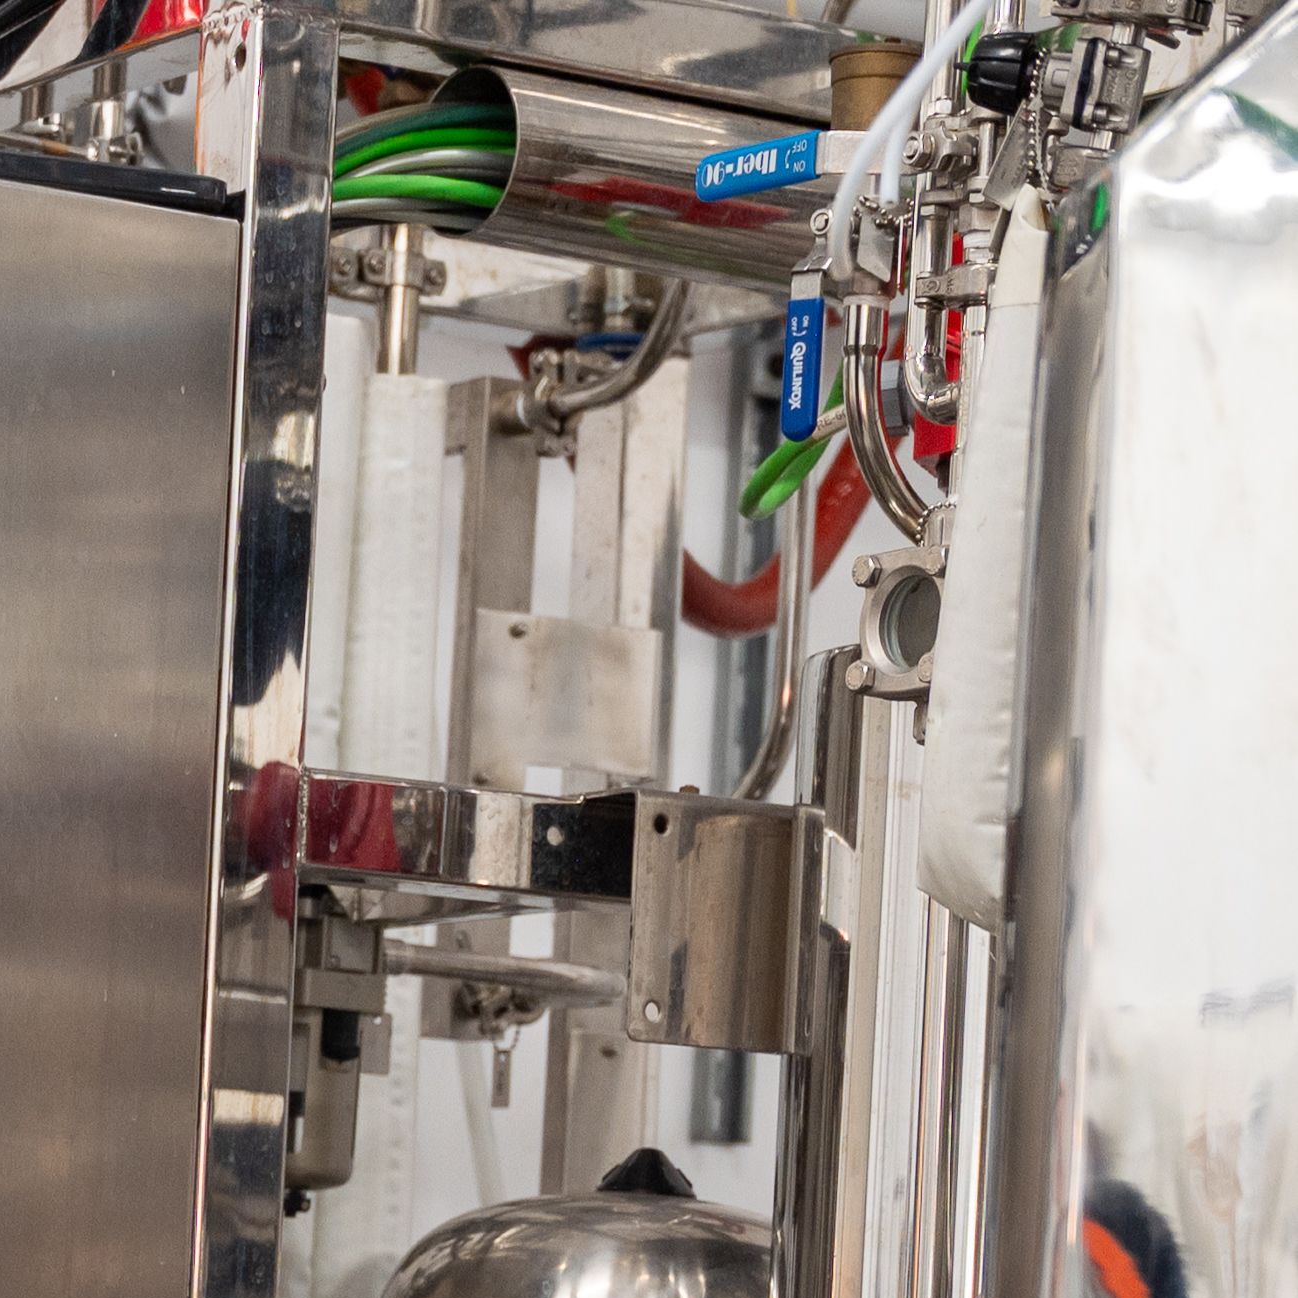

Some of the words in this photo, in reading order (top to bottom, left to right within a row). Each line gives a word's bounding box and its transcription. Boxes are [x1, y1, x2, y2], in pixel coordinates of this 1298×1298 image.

[792, 139, 808, 154] OFF
[701, 148, 778, 188] Iber-90
[793, 160, 806, 173] ON
[788, 341, 807, 411] QUILINOX
